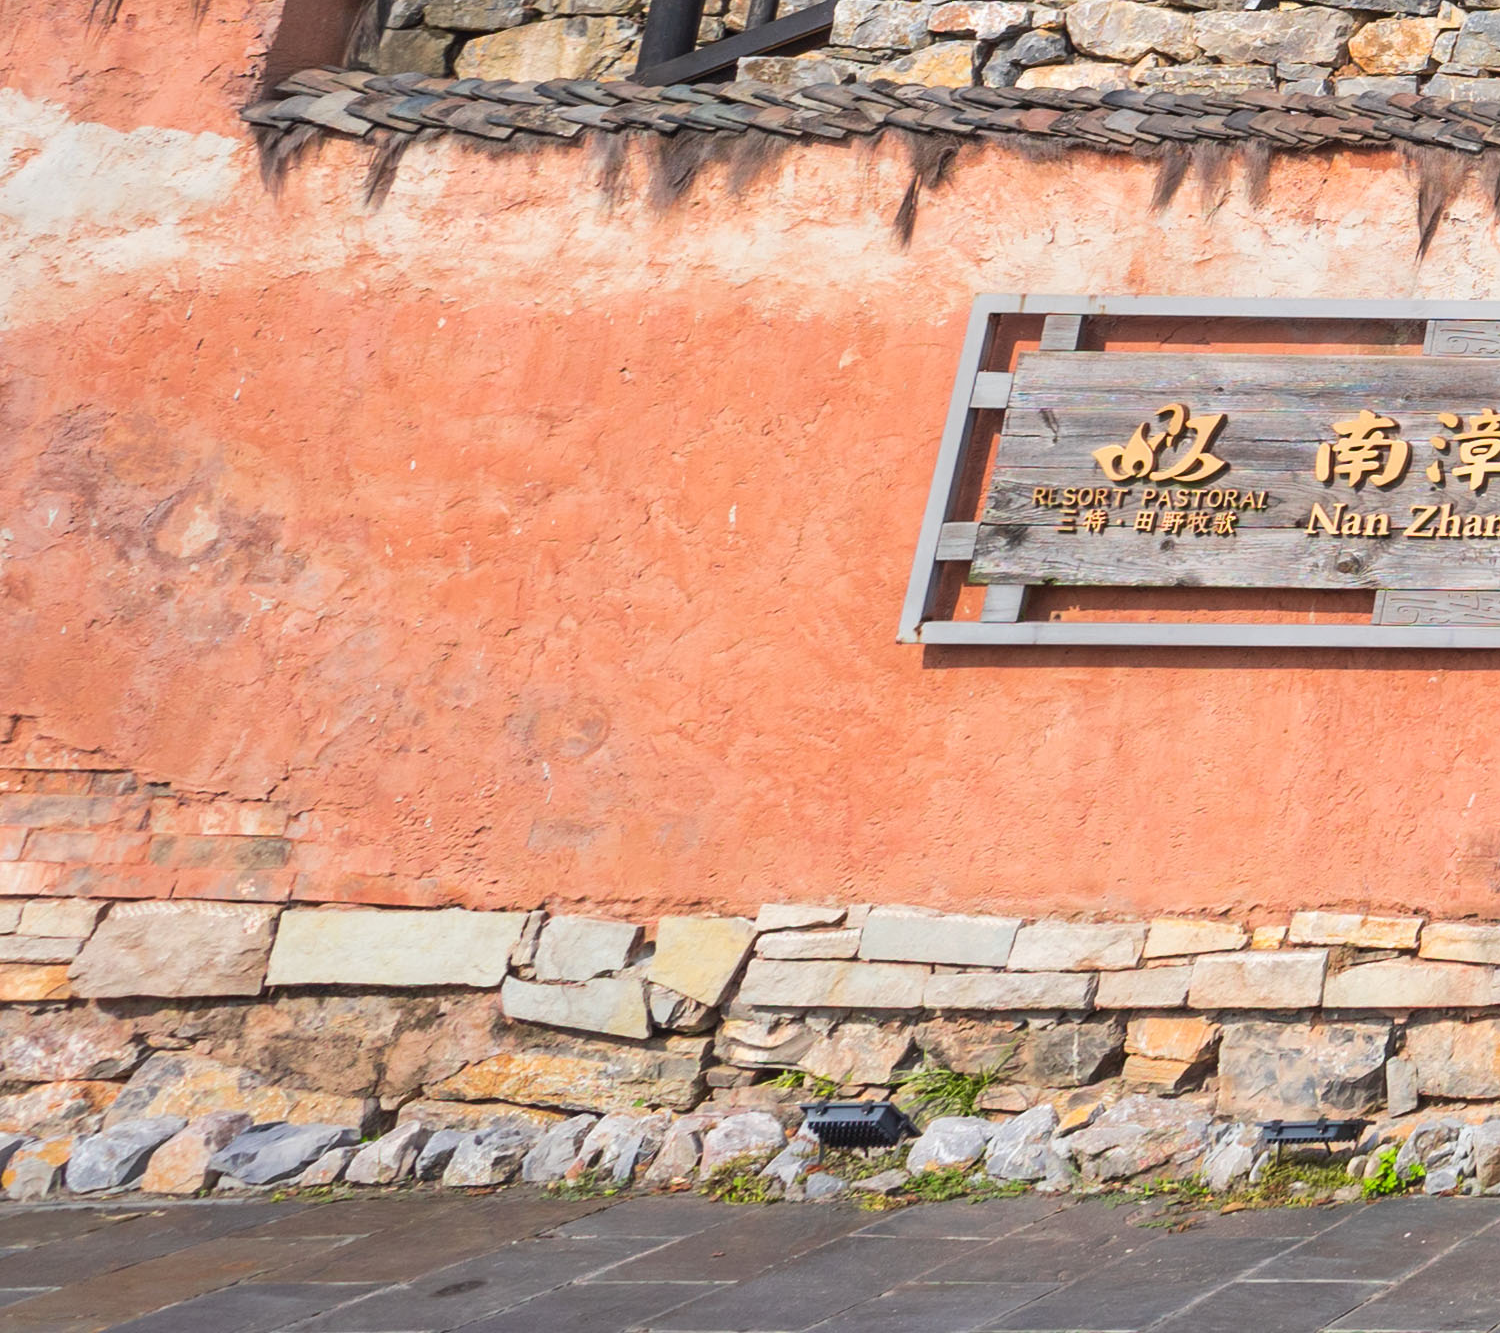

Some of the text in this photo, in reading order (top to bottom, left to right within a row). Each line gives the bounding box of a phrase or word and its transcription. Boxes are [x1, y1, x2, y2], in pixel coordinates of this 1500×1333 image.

[1032, 487, 1269, 509] RESORT PASTORAL
[1304, 502, 1390, 537] Nan
